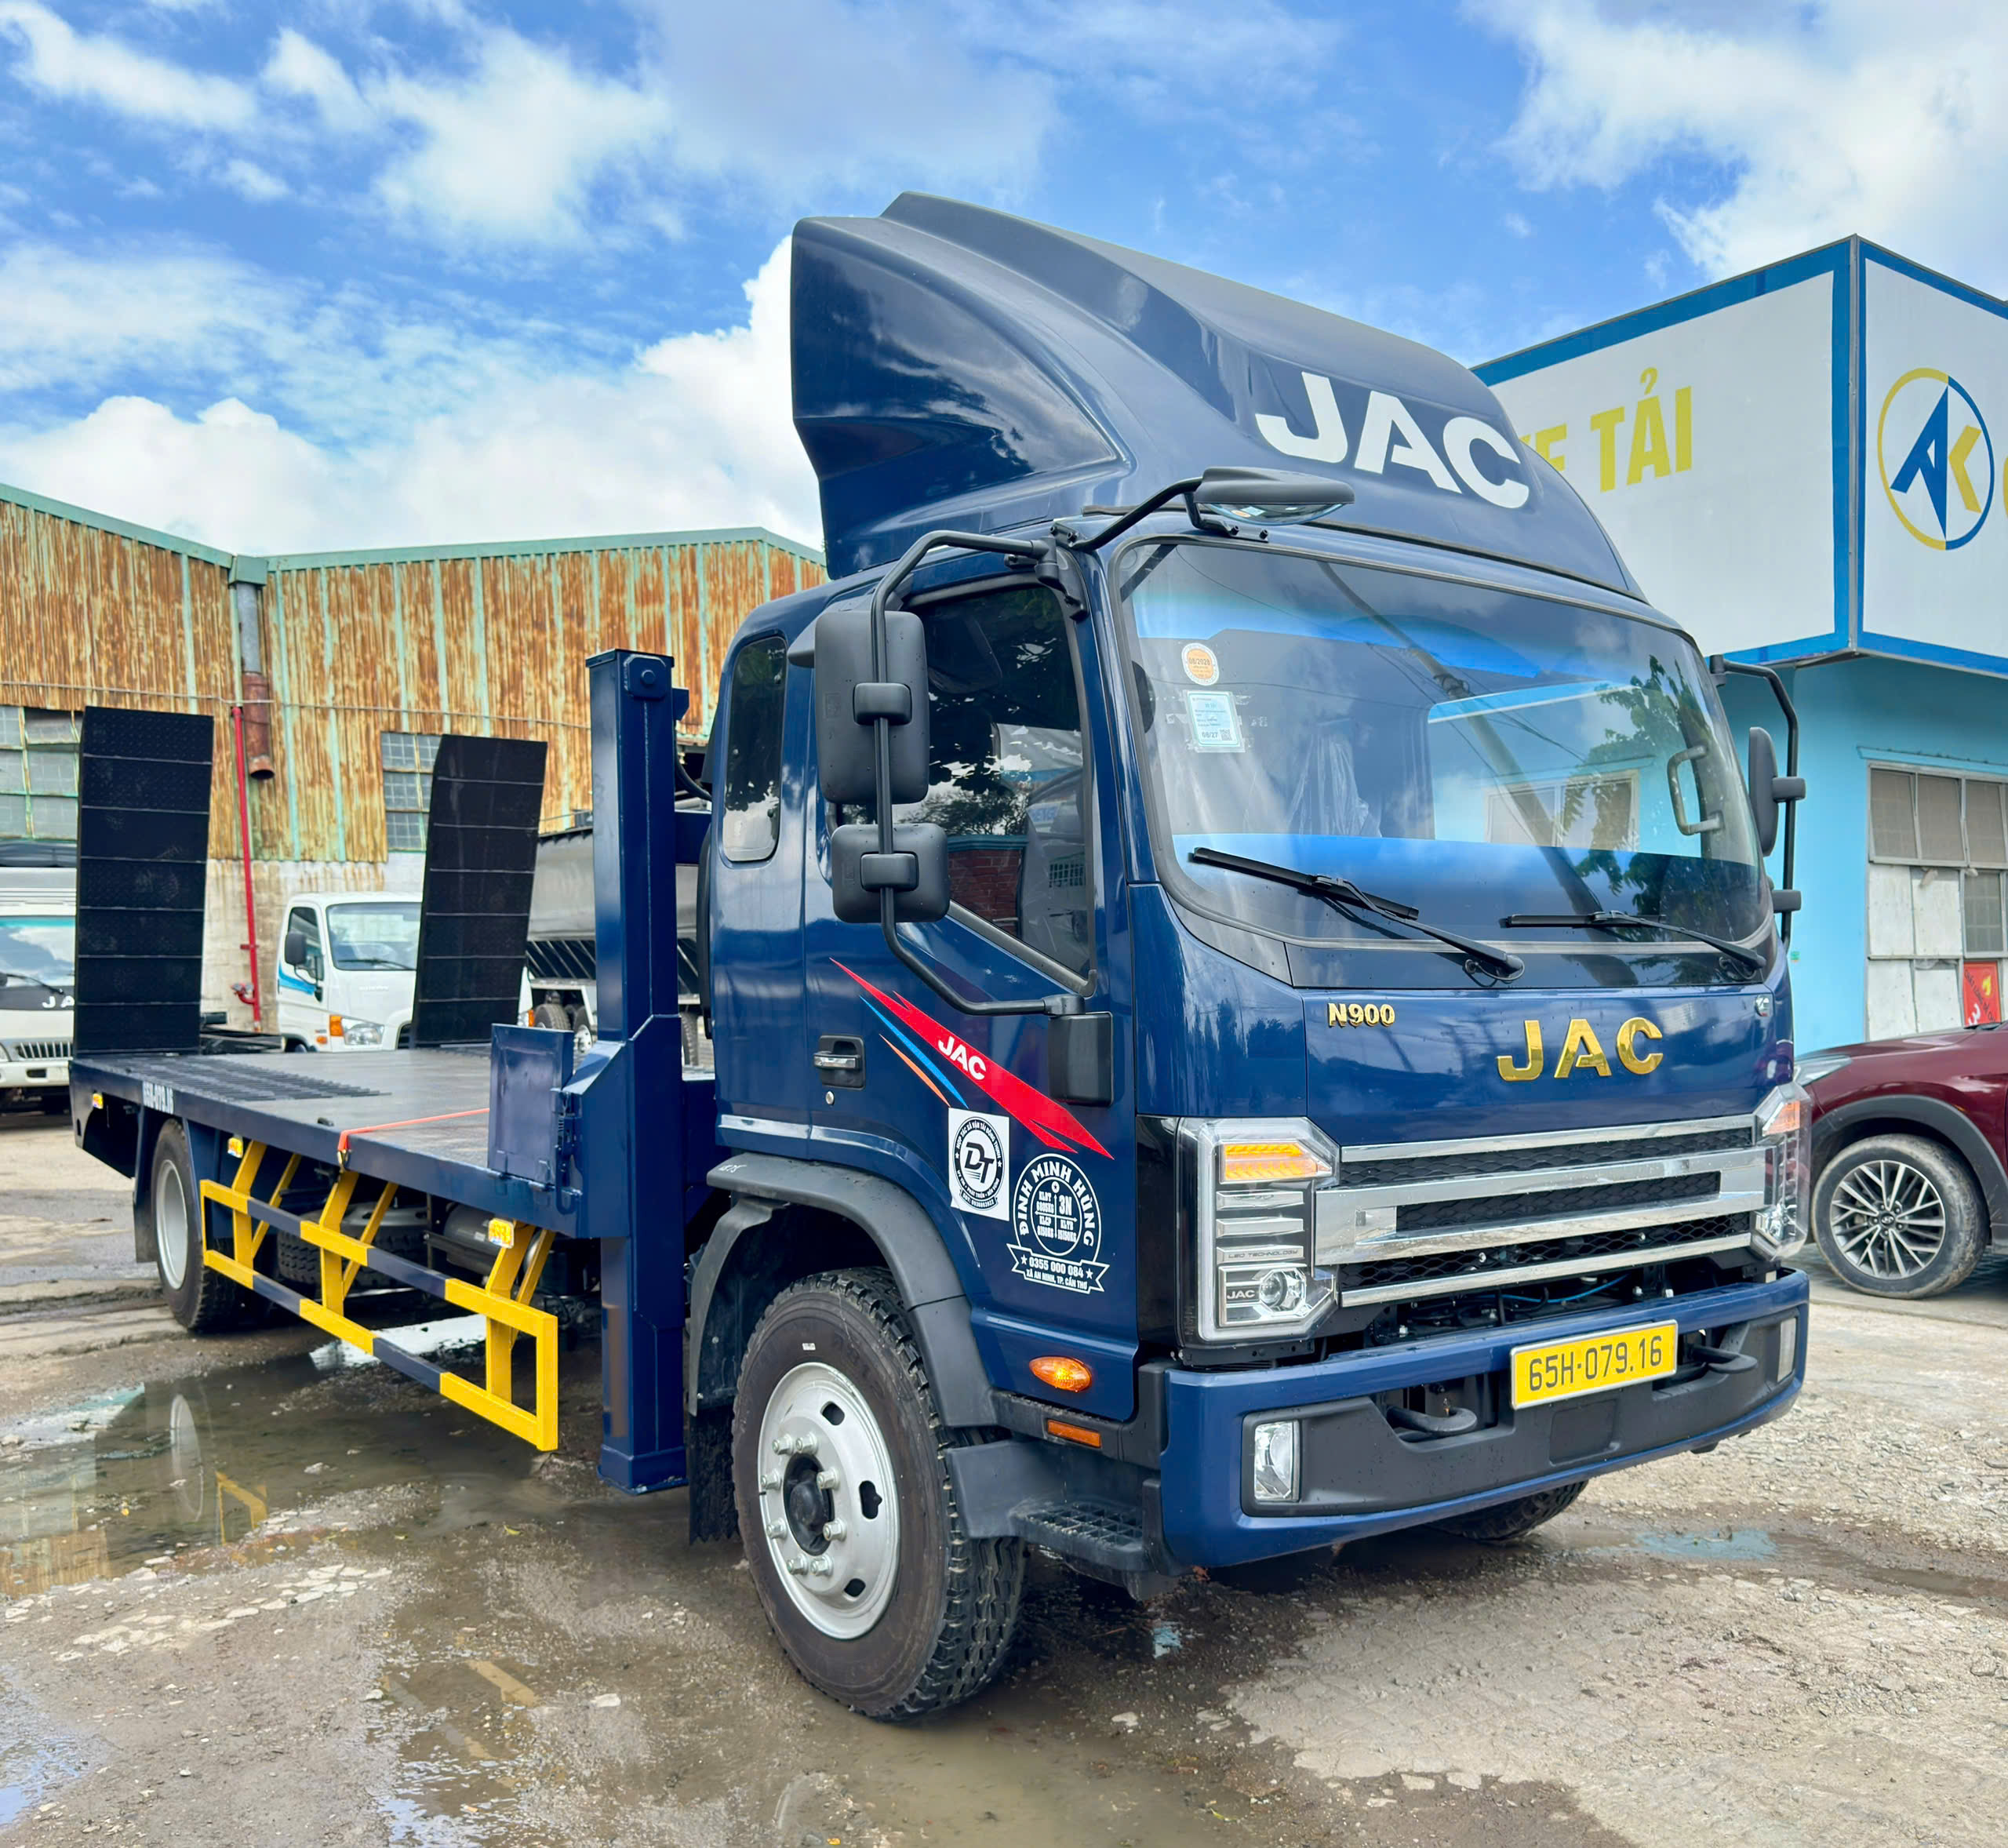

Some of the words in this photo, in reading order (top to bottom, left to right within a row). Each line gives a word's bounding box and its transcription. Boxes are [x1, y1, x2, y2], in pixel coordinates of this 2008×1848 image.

[1255, 371, 1529, 509] JAC
[1519, 422, 1567, 471] E
[1590, 367, 1692, 493] TẢI
[1328, 1002, 1396, 1027] N900
[938, 1035, 987, 1081] JAC
[1497, 1017, 1664, 1082] JAC
[964, 1141, 995, 1184] DT
[1031, 1161, 1072, 1183] MINH
[1059, 1195, 1072, 1216] 3N
[1028, 1257, 1049, 1271] 0355
[1050, 1261, 1066, 1275] 000
[1068, 1265, 1084, 1278] 084
[1034, 1271, 1042, 1280] AN
[1226, 1290, 1256, 1300] JAC
[1530, 1335, 1662, 1391] 65H-079.16
